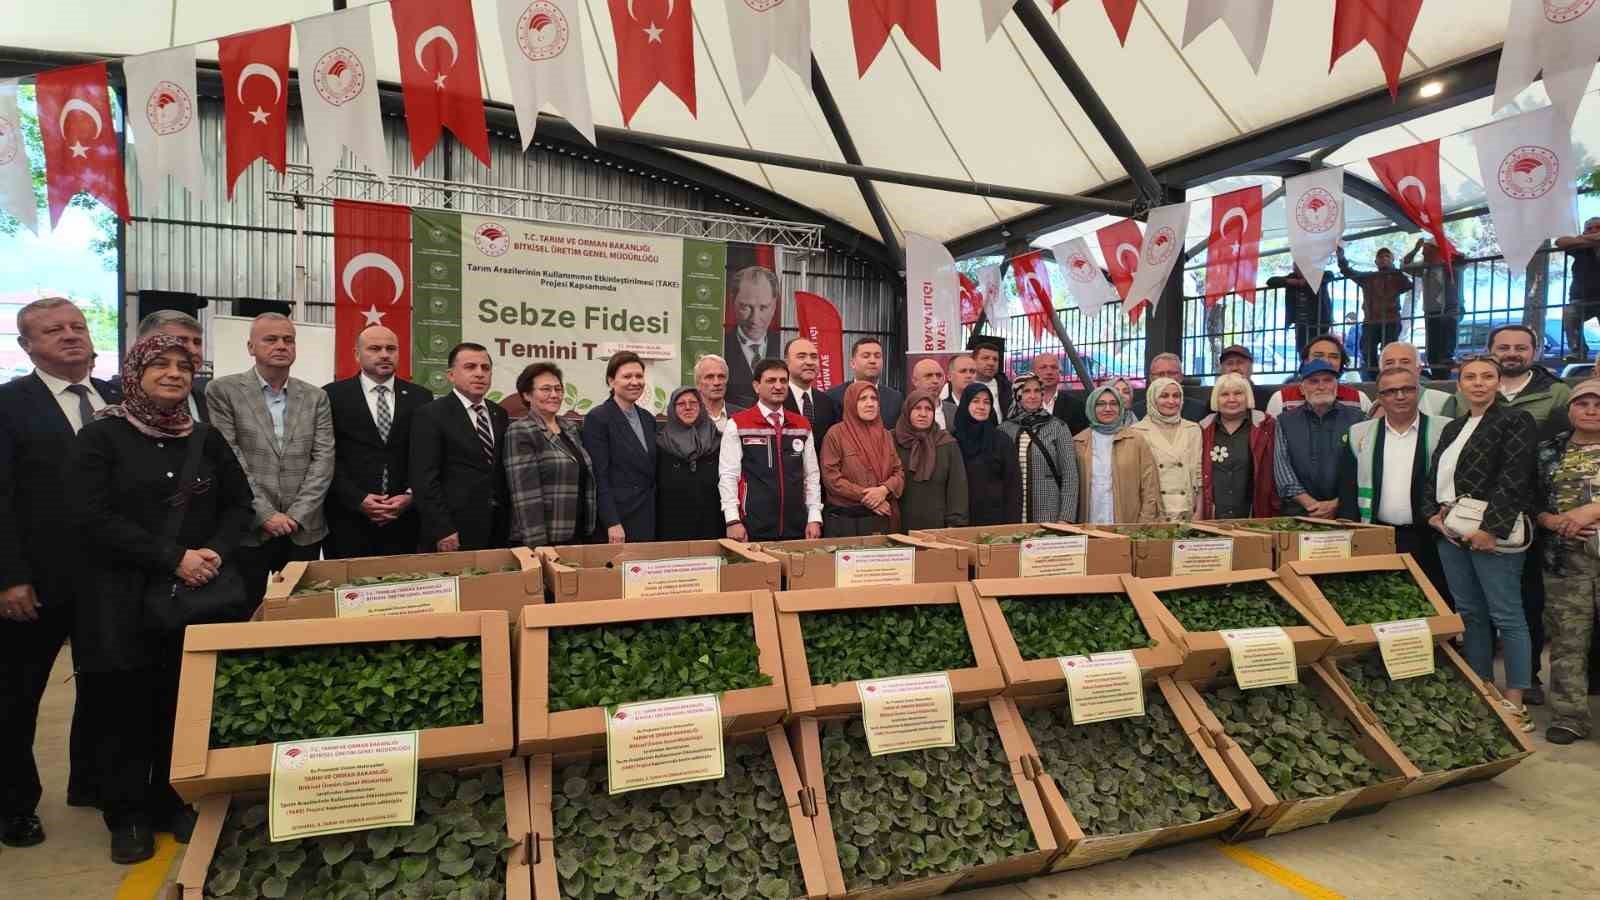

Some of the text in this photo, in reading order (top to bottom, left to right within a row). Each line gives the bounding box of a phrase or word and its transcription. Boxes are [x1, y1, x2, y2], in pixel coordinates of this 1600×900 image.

[524, 232, 538, 241] T.C.
[540, 234, 563, 243] TARIM
[578, 238, 608, 248] ORMAN
[609, 240, 651, 252] BAKANLIĞI
[583, 248, 608, 258] GENEL
[466, 264, 492, 273] Tarım
[494, 266, 541, 276] Arazilerinin
[540, 278, 617, 292] Projesi Kapsamında
[478, 298, 669, 334] Sebze Fidesi
[494, 338, 576, 360] Temini
